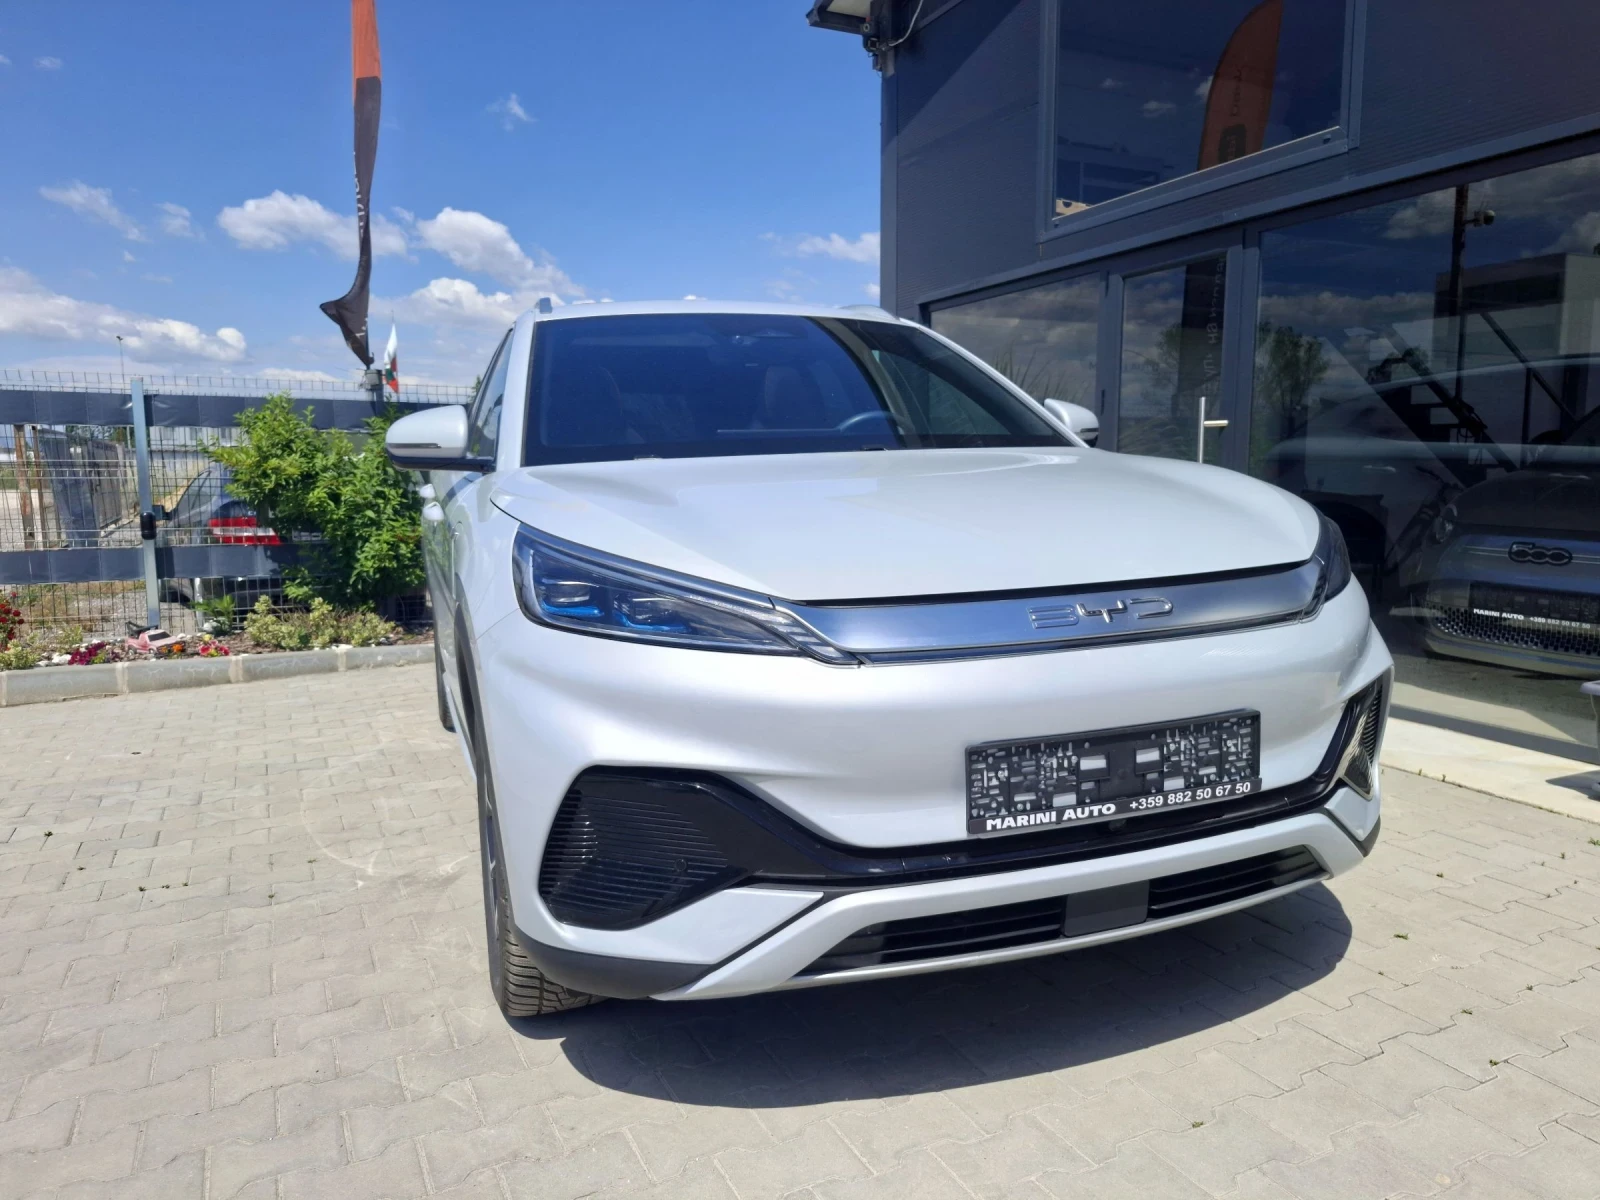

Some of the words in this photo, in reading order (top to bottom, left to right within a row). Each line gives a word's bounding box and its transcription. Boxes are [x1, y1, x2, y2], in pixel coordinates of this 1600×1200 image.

[1508, 541, 1573, 566] 500
[1026, 597, 1174, 629] BYD
[1473, 608, 1500, 617] MARINI
[1501, 612, 1524, 620] AUTO
[986, 811, 1057, 831] MARINI
[1062, 803, 1116, 822] AUTO
[1129, 796, 1164, 811] +359
[1167, 791, 1193, 805] 882
[1196, 787, 1212, 800] 50
[1215, 785, 1231, 797] 67
[1235, 781, 1251, 794] 50
